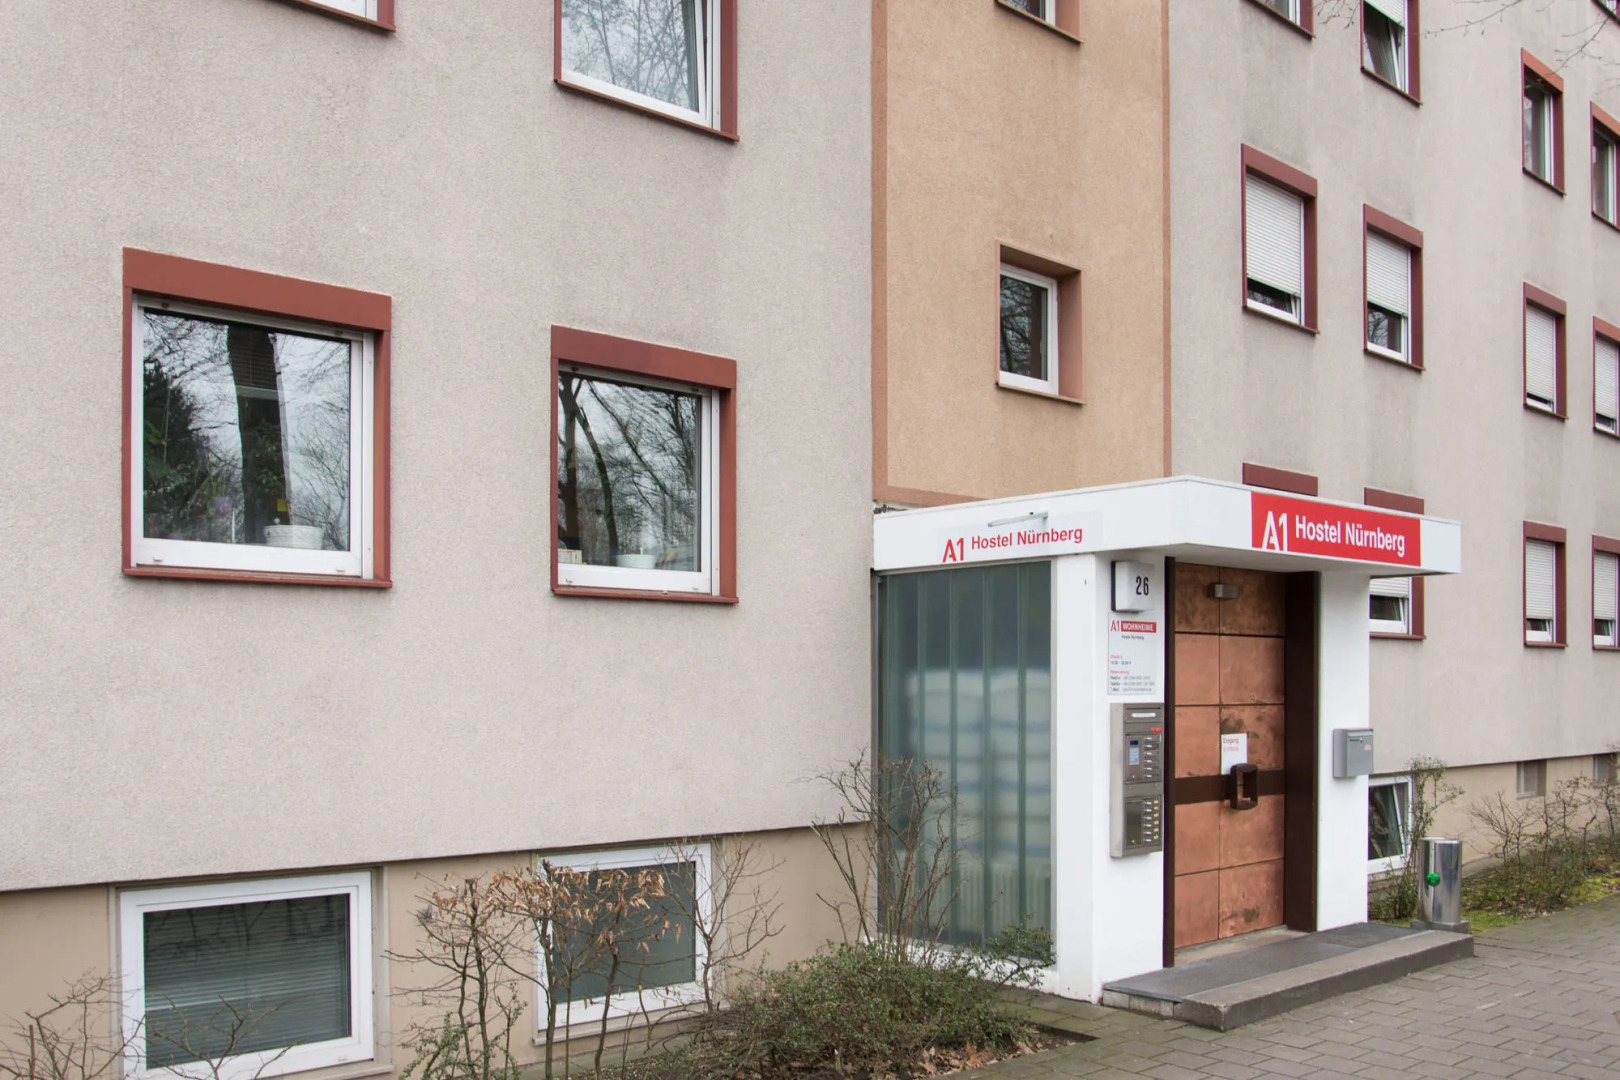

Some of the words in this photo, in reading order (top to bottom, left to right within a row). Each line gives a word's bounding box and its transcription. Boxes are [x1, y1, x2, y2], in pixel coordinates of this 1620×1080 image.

[942, 537, 965, 563] A1
[971, 532, 1013, 550] Hostel
[1017, 527, 1083, 546] Nürnberg
[1261, 510, 1288, 552] A1
[1295, 514, 1341, 544] Hostel
[1345, 521, 1405, 558] Nürnberg
[1135, 575, 1149, 596] 26
[1110, 619, 1120, 632] A1
